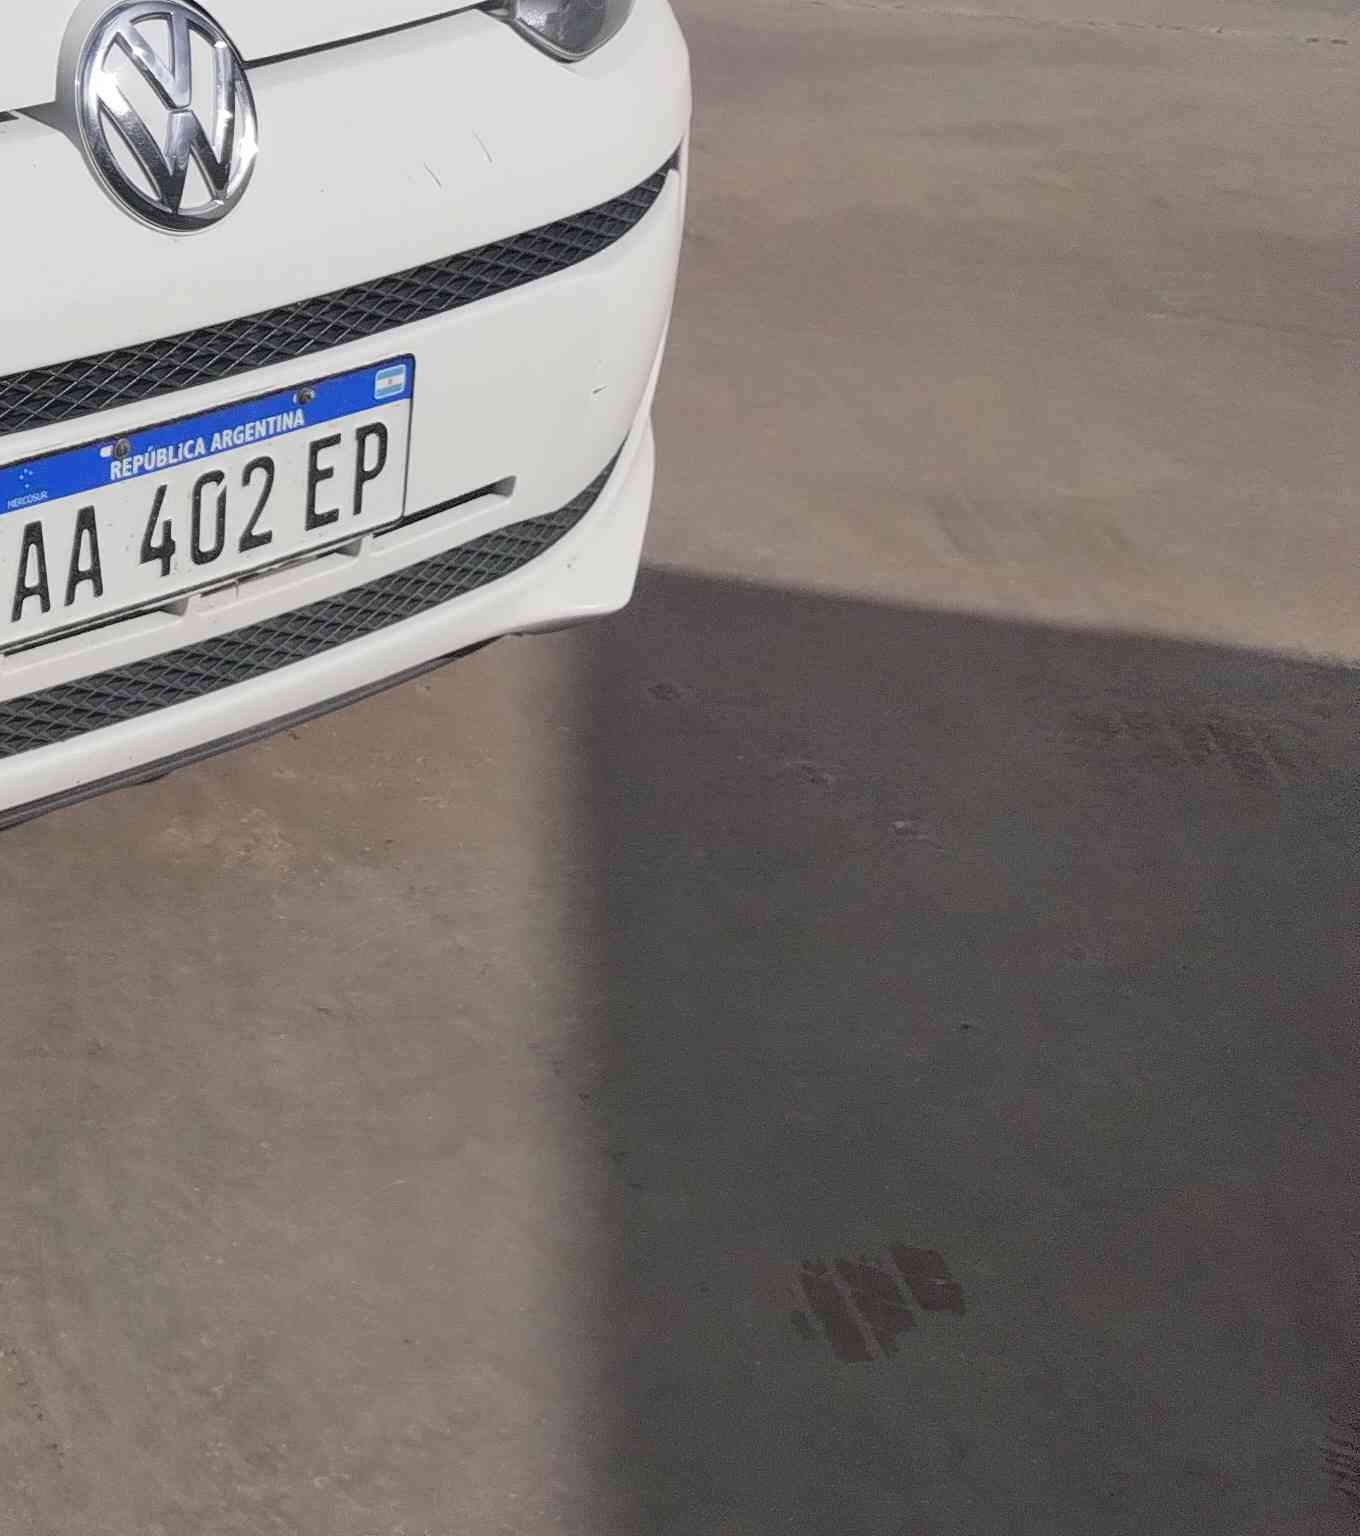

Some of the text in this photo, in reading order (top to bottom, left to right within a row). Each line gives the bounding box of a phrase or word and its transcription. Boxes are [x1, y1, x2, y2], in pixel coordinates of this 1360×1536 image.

[110, 408, 306, 482] REPÚBLICA ARGENTINA
[11, 420, 389, 623] AA 402 EP
